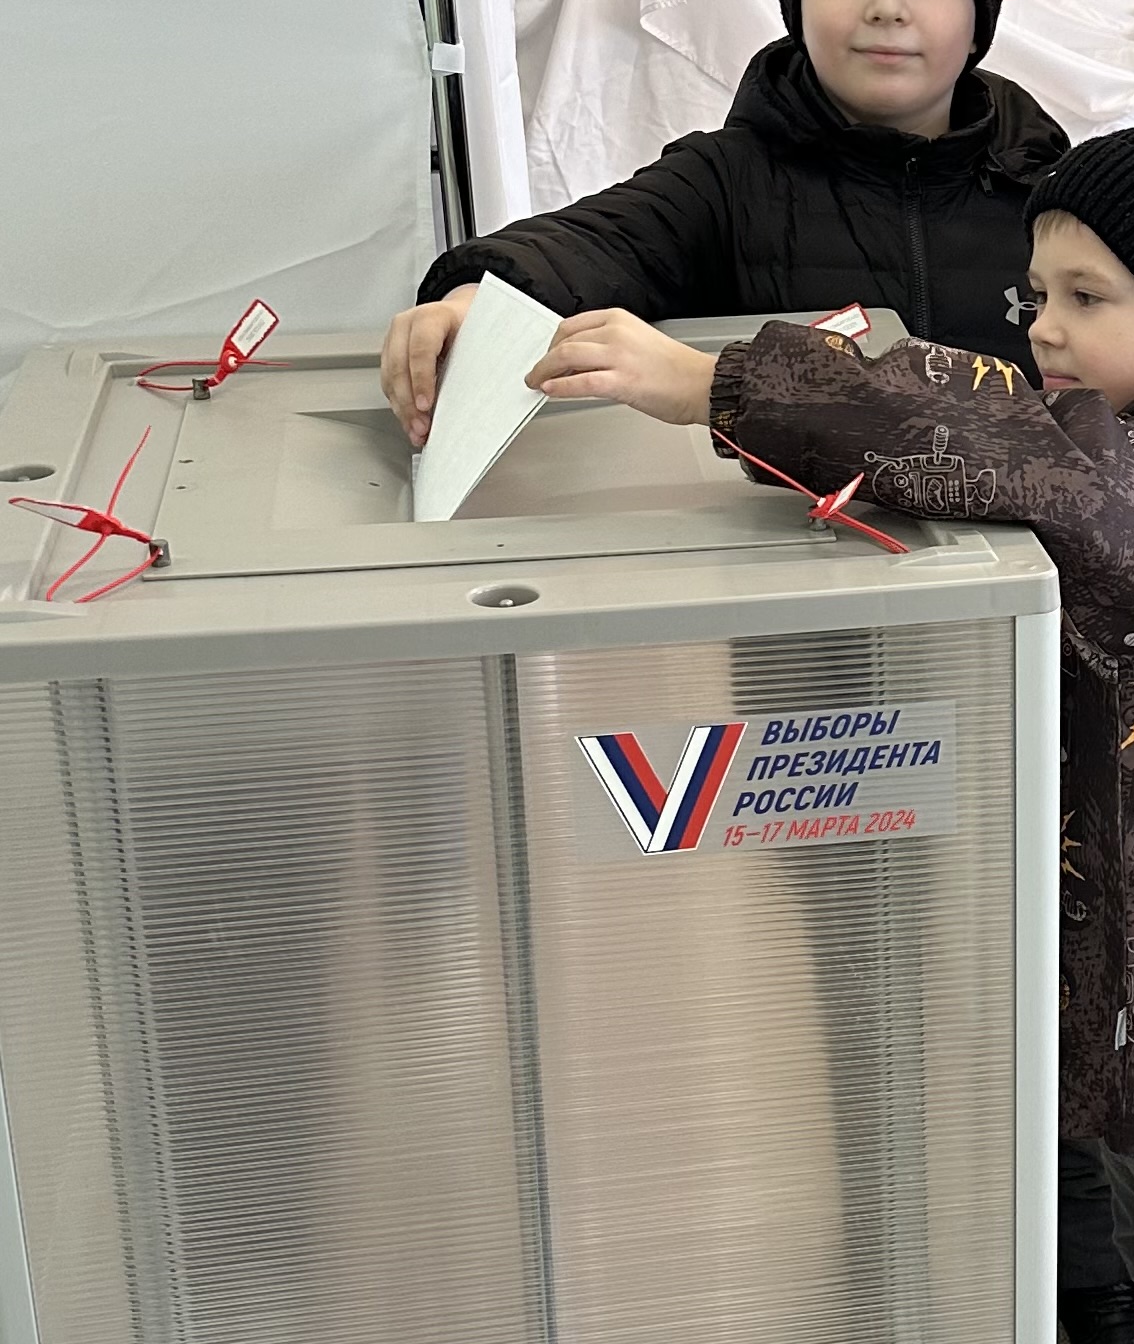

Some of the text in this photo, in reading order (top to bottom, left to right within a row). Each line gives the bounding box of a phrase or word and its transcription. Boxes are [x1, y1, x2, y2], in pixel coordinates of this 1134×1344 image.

[760, 709, 901, 746] ВЫБОРЫ
[746, 740, 942, 781] ПРЕЗИДЕНТА
[731, 781, 860, 817] РОССИИ
[785, 814, 862, 842] МАРТА
[863, 808, 917, 834] 2024
